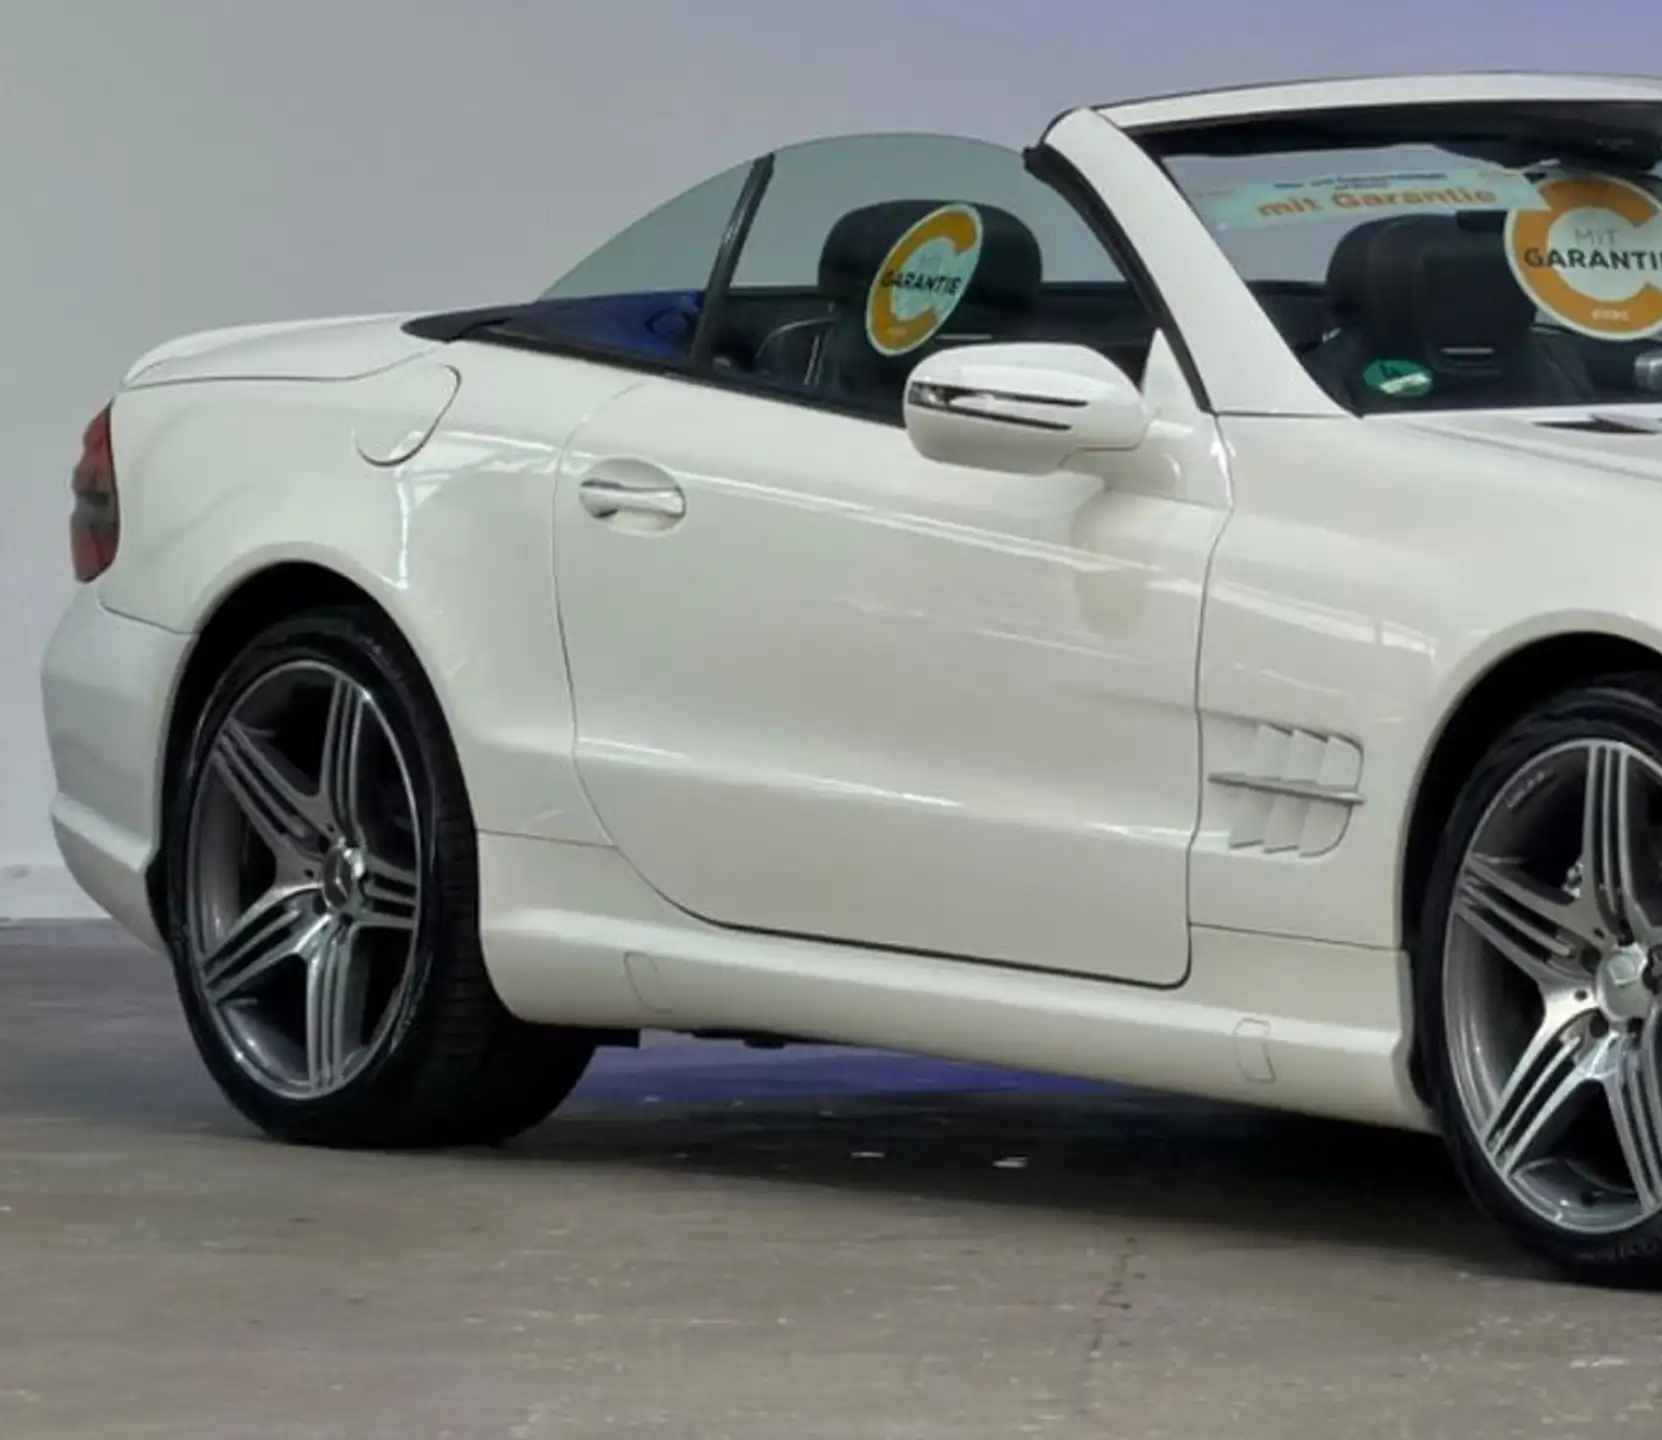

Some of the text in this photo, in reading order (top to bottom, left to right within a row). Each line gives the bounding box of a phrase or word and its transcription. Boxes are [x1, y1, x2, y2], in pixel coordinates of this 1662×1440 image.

[1331, 186, 1498, 210] Garantie
[1575, 227, 1620, 246] MIT
[880, 269, 962, 296] GARANTIE
